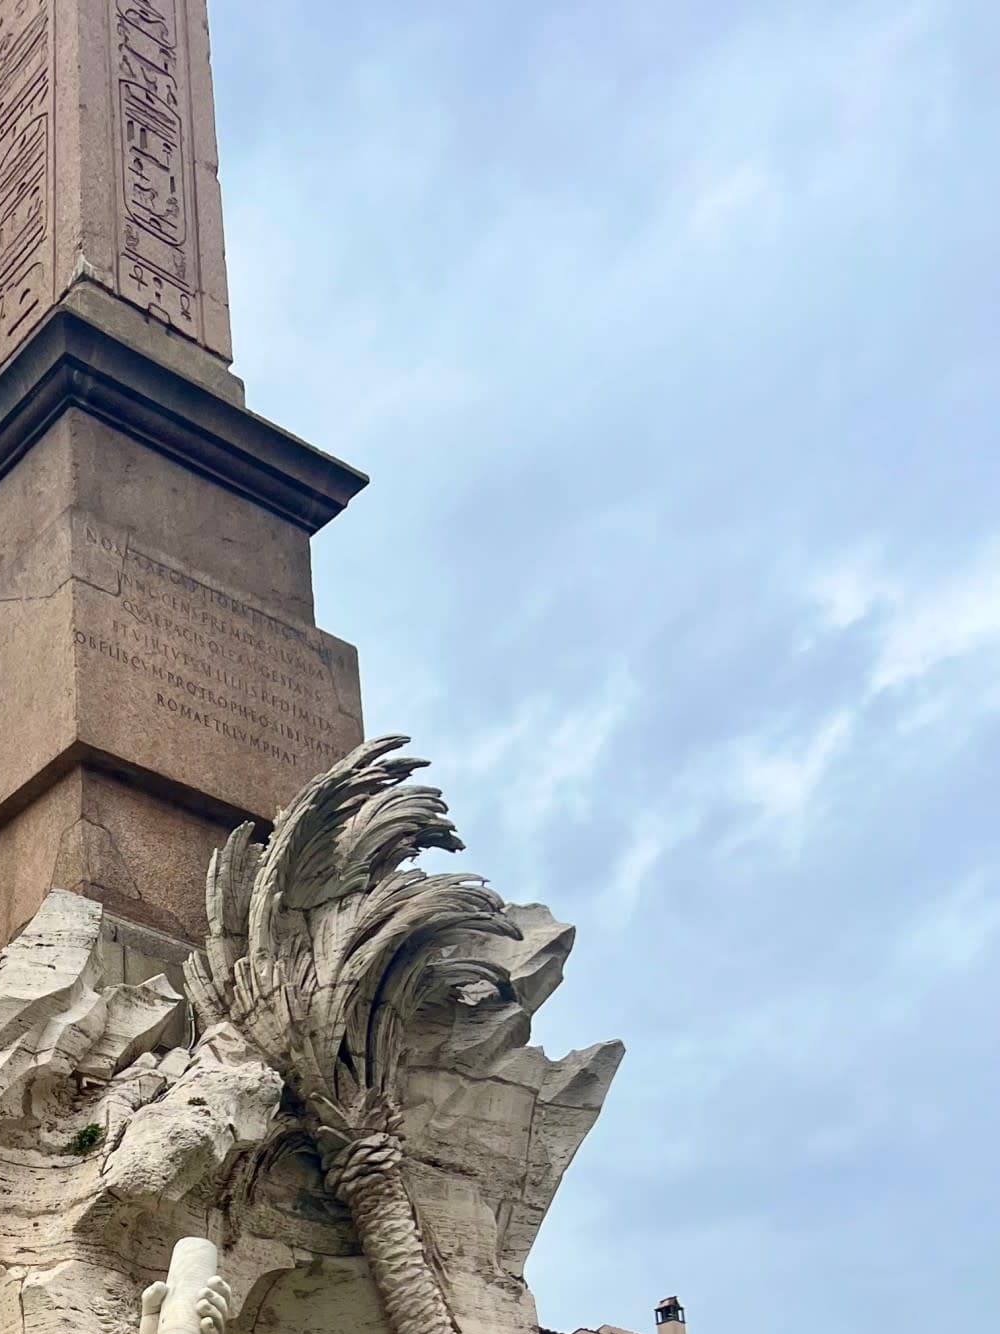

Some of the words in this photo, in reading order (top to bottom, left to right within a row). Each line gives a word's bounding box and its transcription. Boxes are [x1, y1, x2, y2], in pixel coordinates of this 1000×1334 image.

[164, 618, 204, 649] PACIS
[74, 630, 164, 681] OBELISCVM
[167, 671, 198, 696] PRO
[198, 686, 270, 729] TROPHEO
[156, 692, 211, 729] ROMAE
[212, 718, 298, 766] TRIVMPHAT
